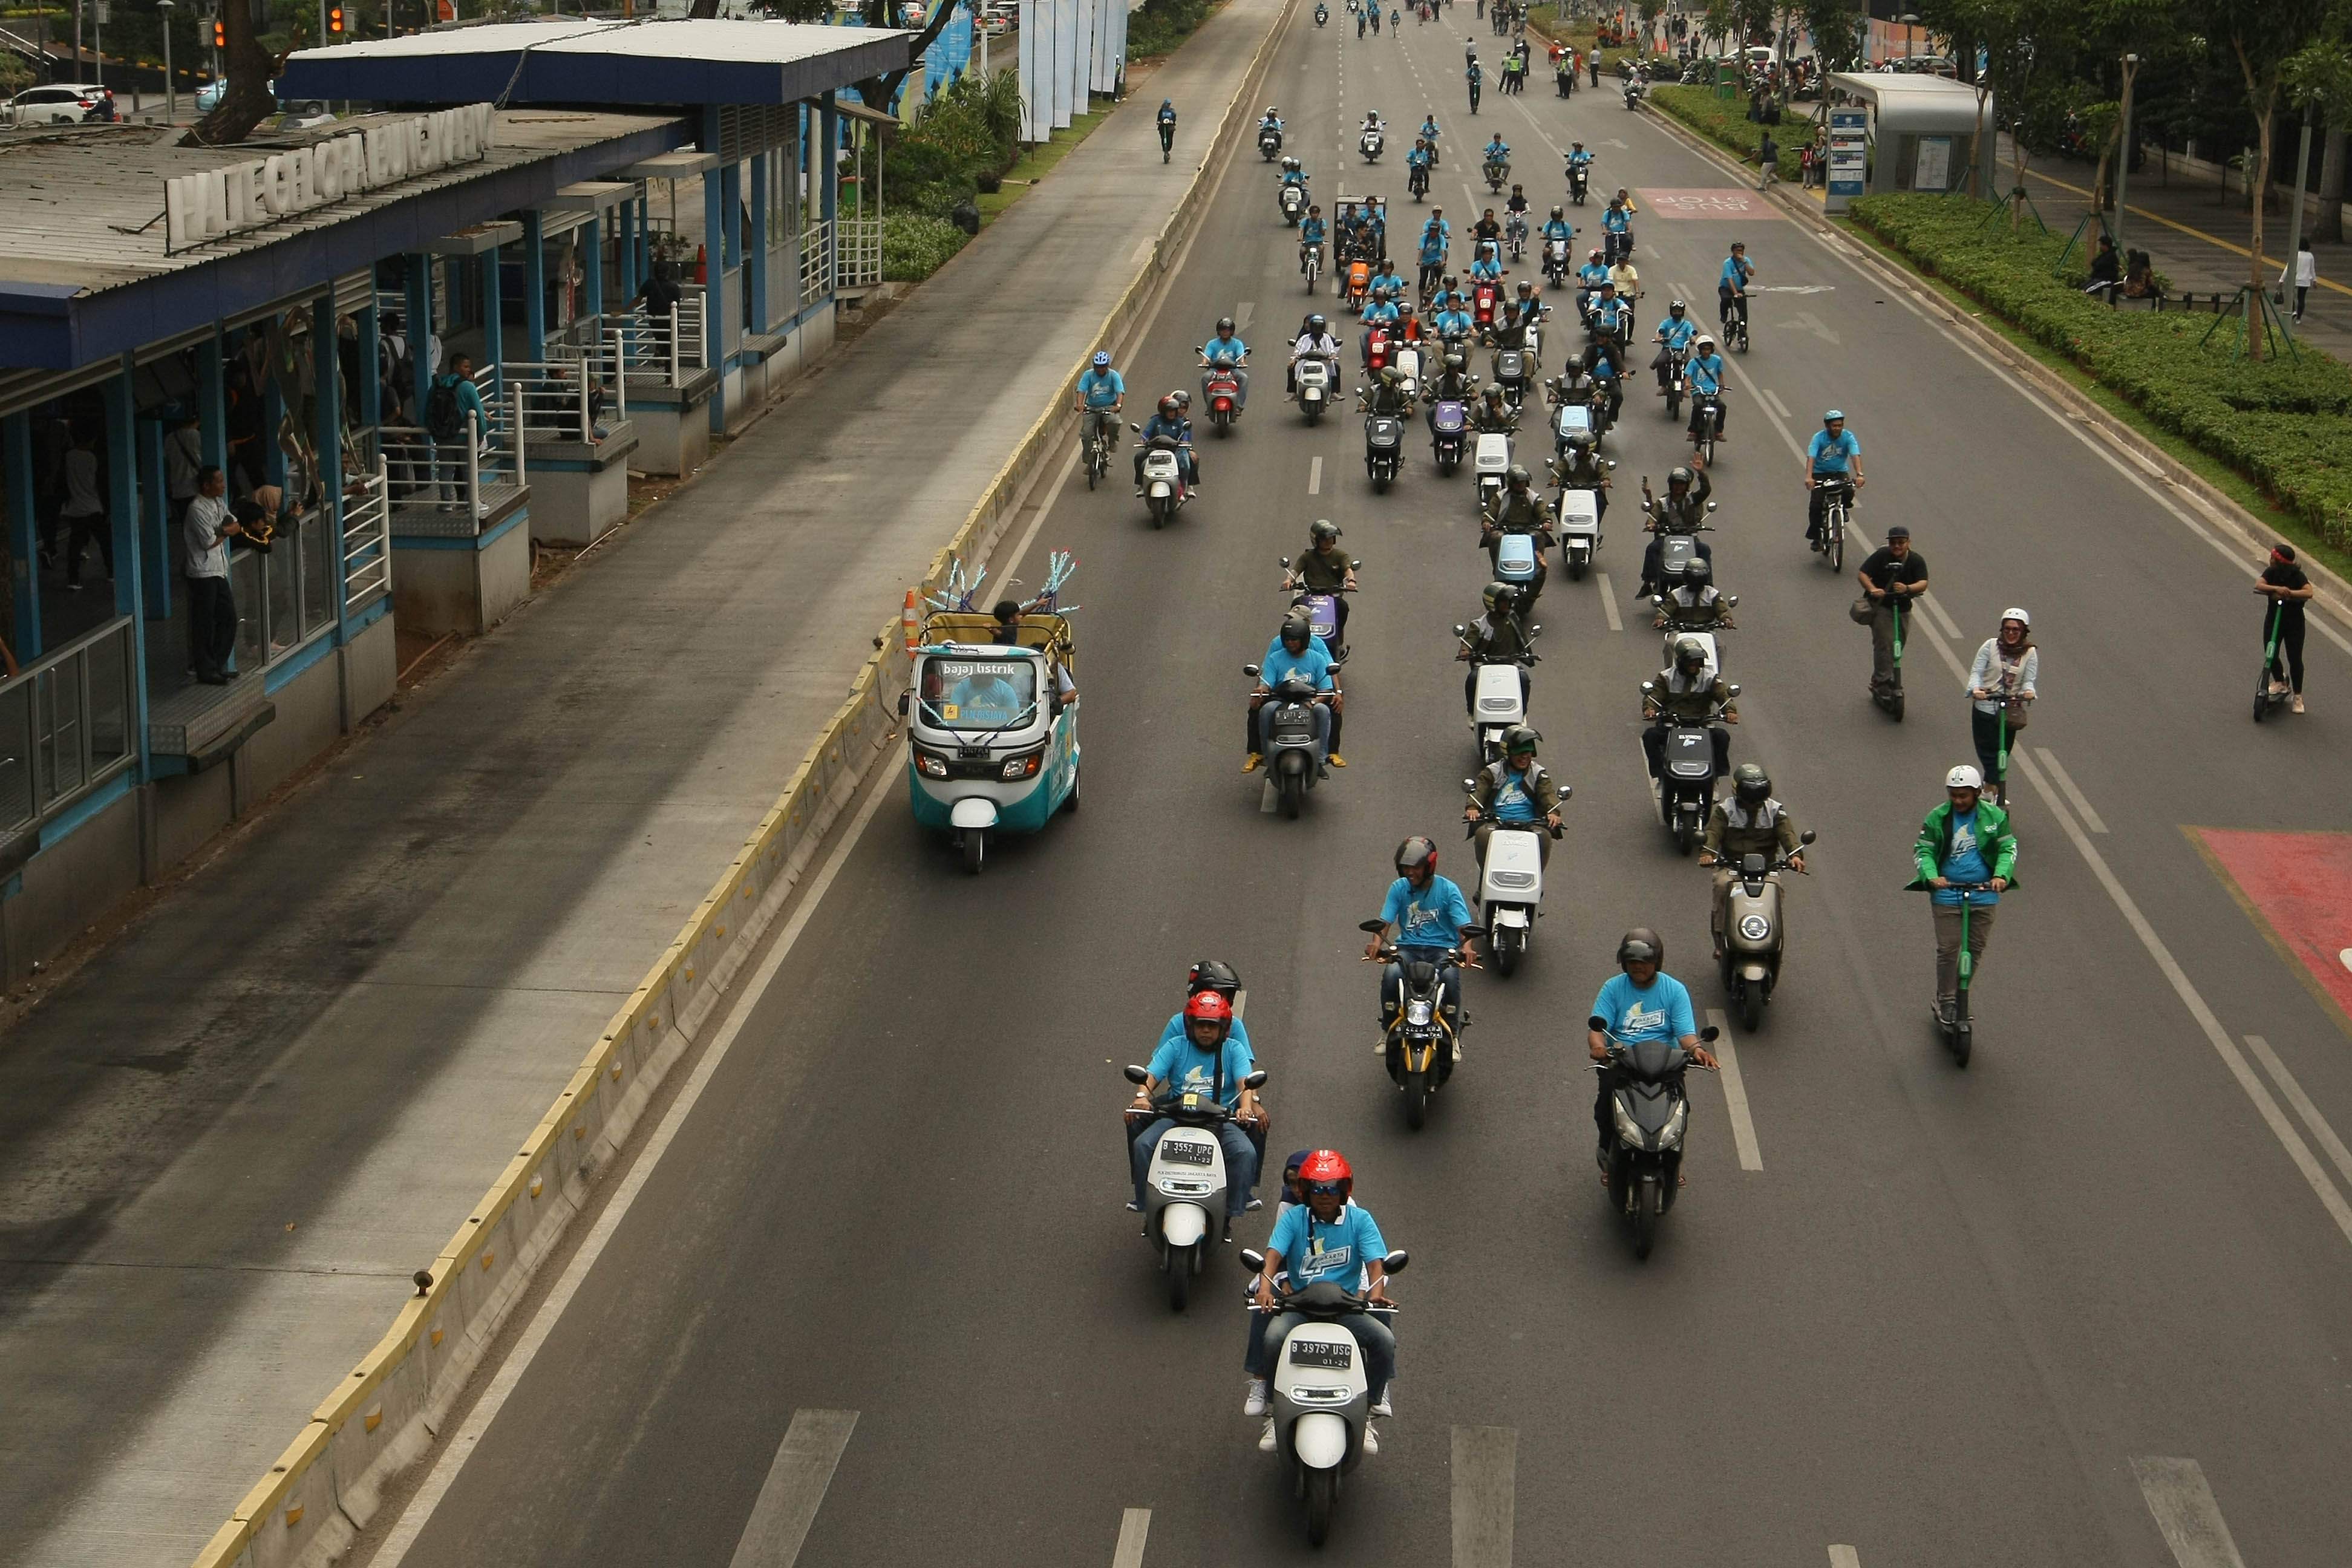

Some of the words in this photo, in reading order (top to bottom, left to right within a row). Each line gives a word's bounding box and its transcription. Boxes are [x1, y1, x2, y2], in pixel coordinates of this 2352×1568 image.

[944, 664, 973, 676] bajaj
[977, 664, 1014, 675] listrik
[1163, 1141, 1168, 1150] B
[1173, 1142, 1193, 1152] 3552
[1292, 1342, 1298, 1353] B
[1302, 1342, 1327, 1354] 3975
